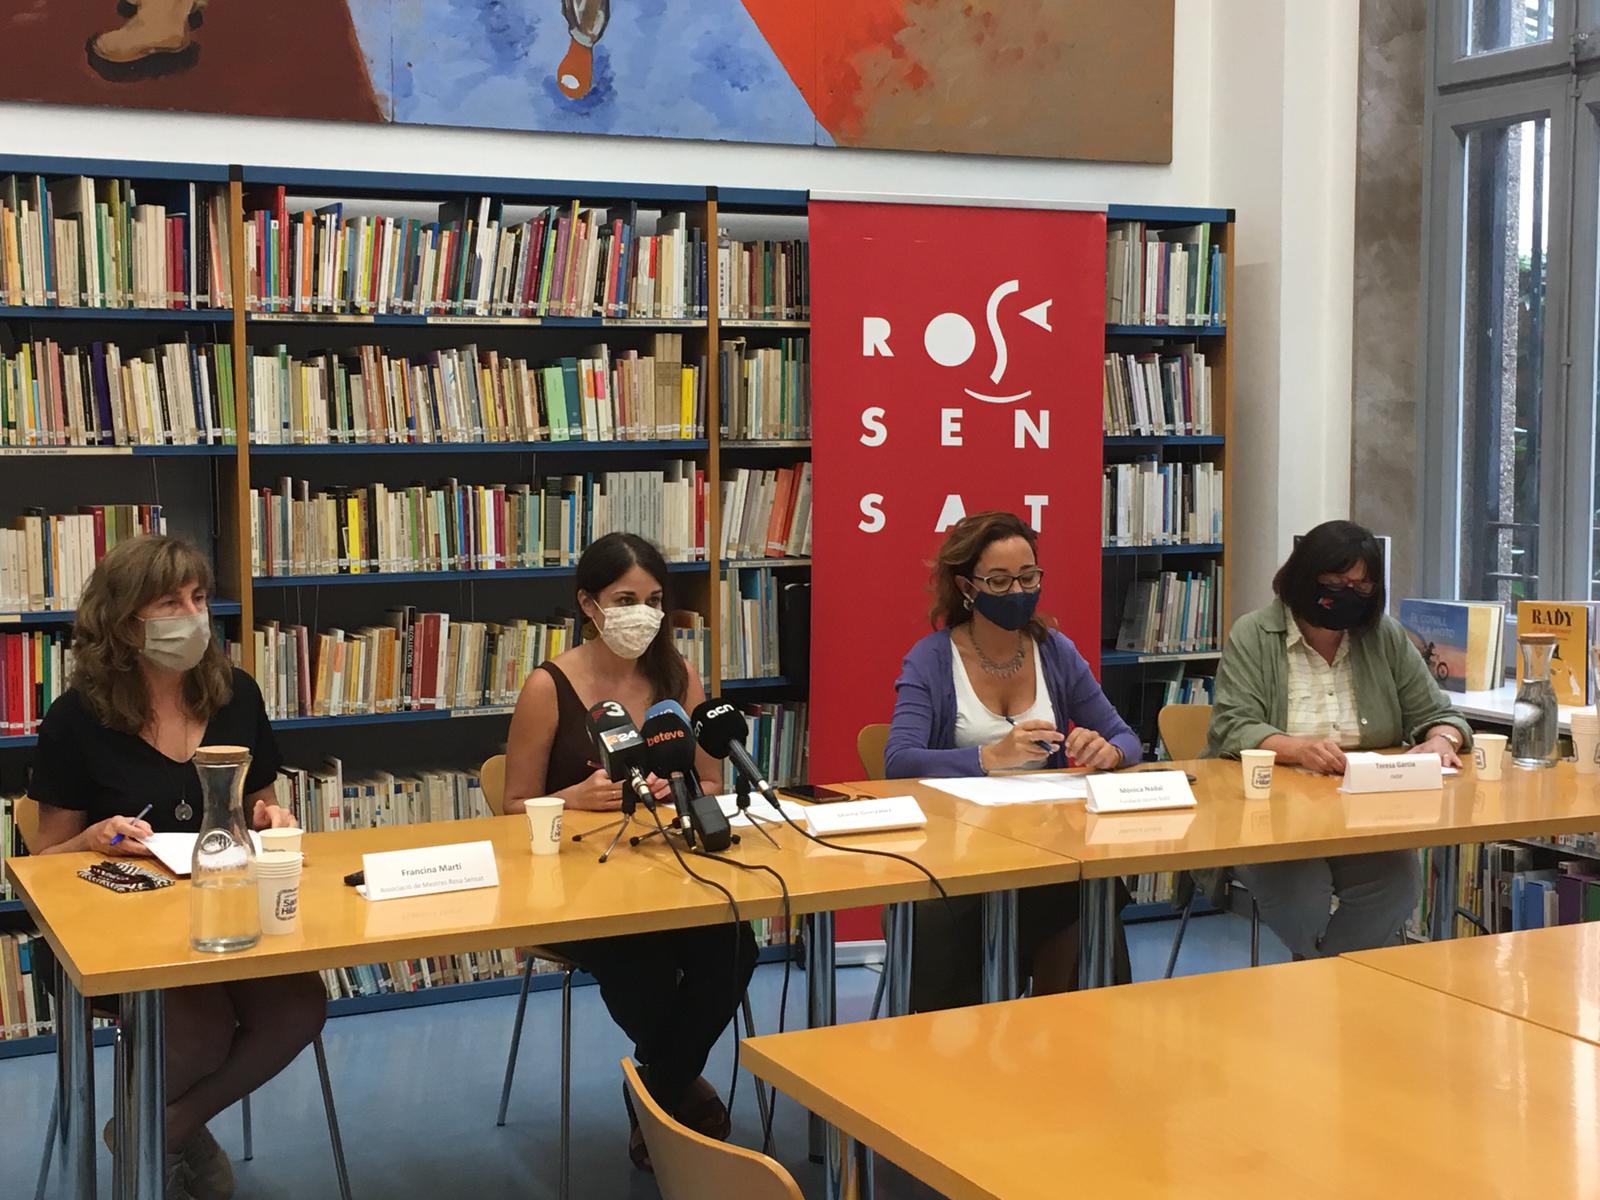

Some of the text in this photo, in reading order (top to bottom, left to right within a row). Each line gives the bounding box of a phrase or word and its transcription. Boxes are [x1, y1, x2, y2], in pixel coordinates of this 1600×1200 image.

[863, 279, 1052, 384] ROSA
[706, 704, 735, 719] acn
[401, 862, 462, 877] Francina Martí
